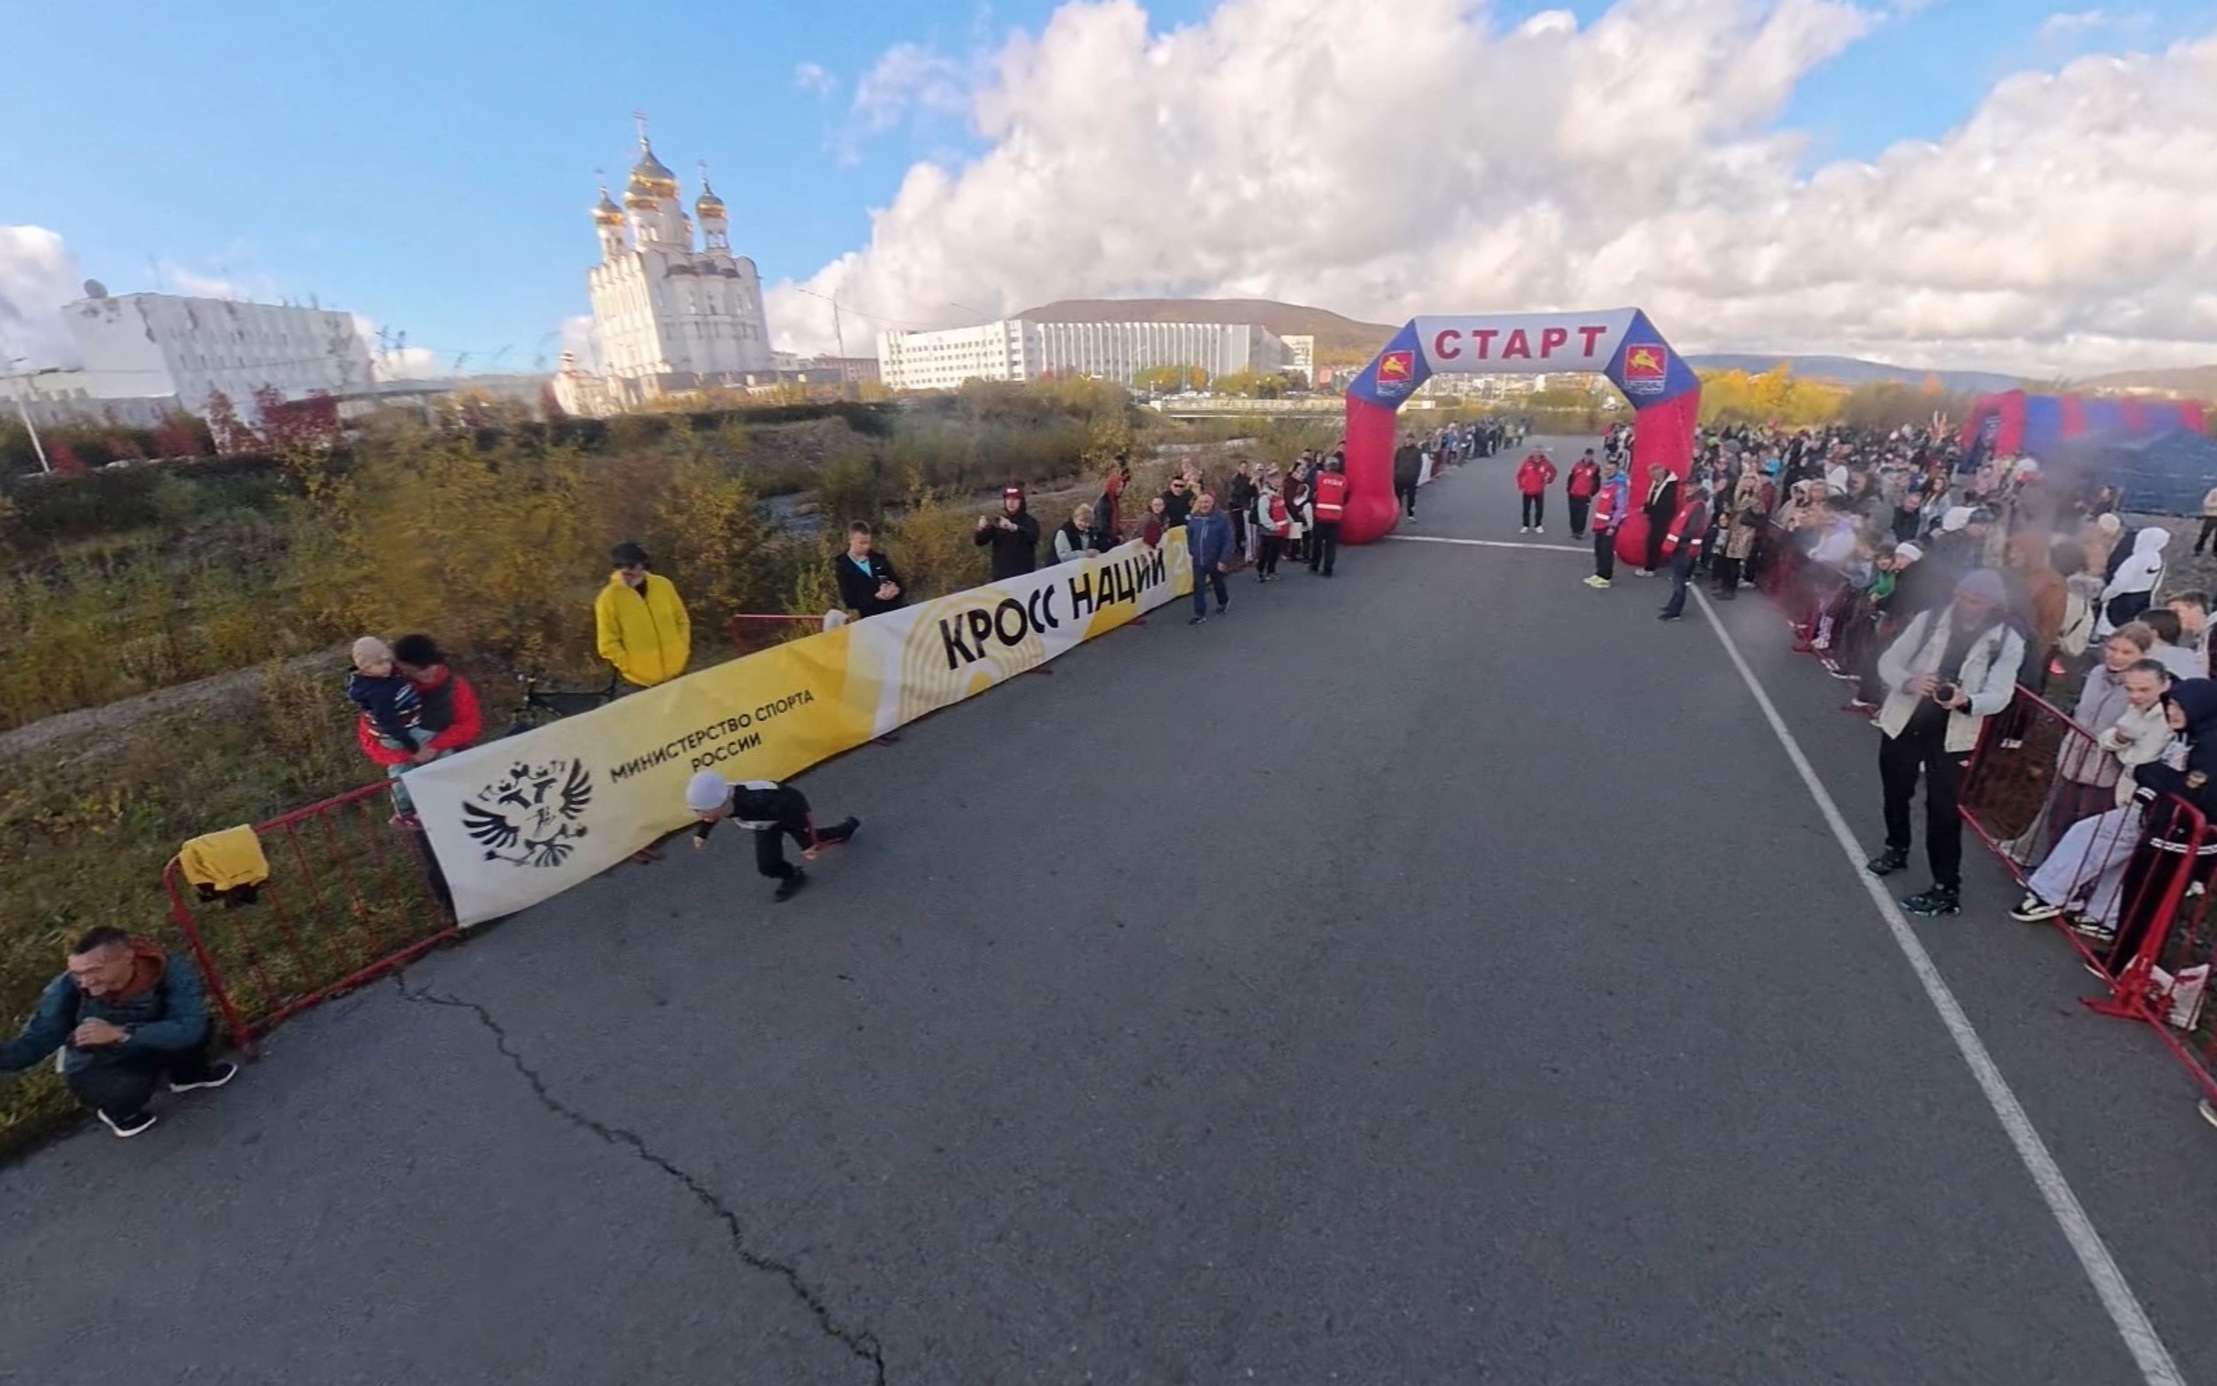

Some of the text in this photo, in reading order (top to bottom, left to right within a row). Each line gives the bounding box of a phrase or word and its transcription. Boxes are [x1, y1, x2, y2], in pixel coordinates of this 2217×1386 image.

[1434, 326, 1608, 360] СТАРТ
[938, 584, 1059, 670] КРОСС
[1068, 548, 1166, 620] НАЦИИ
[609, 689, 814, 784] МИНИСТЕРСТВО СПОРТА
[690, 732, 762, 773] РОССИИ
